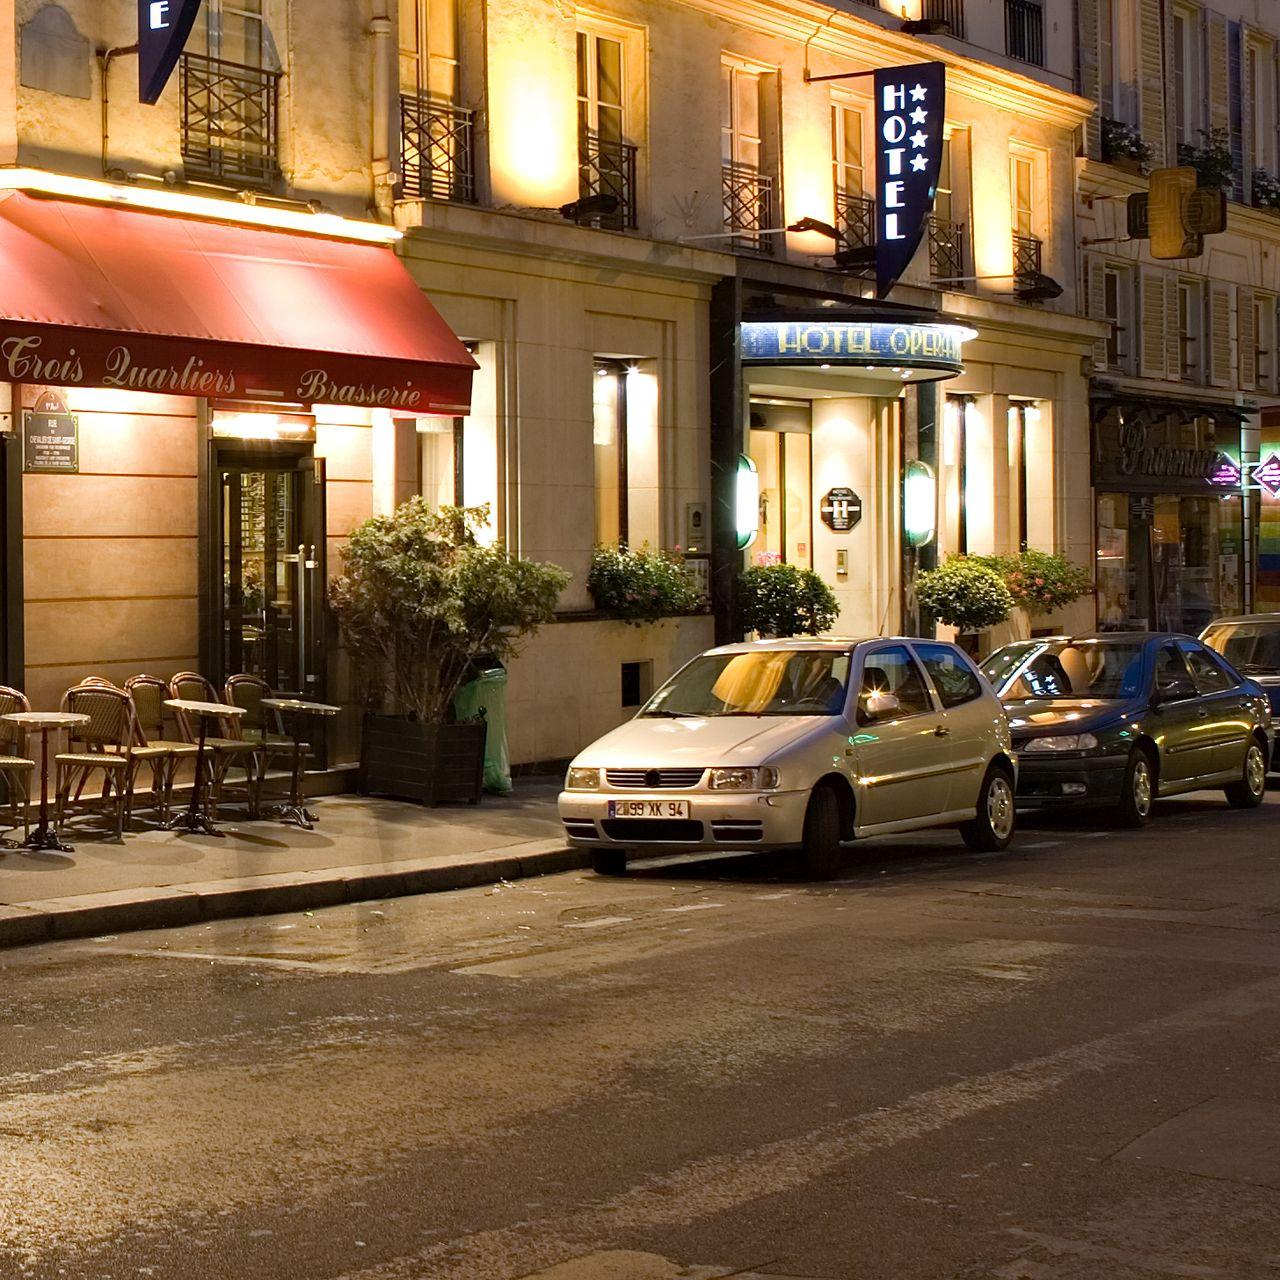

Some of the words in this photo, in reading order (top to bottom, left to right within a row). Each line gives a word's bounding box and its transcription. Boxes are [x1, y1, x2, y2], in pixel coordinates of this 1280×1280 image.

[882, 83, 907, 241] HOTEL
[777, 325, 881, 354] HOTEL
[1, 336, 84, 383] Trois
[102, 345, 236, 395] Quartiers
[296, 368, 423, 407] Brasserie
[648, 802, 663, 817] XK
[668, 802, 684, 817] 94
